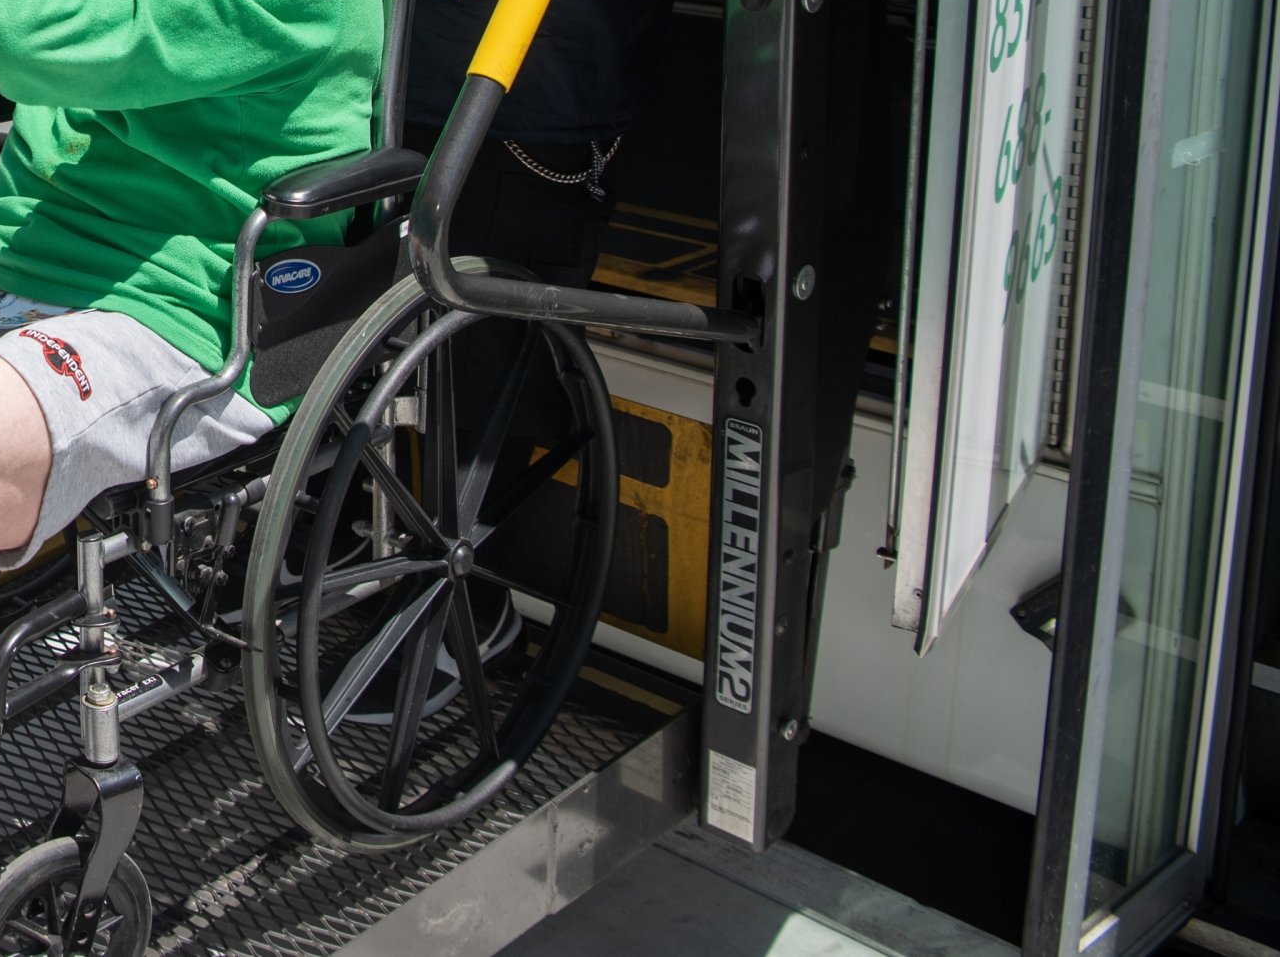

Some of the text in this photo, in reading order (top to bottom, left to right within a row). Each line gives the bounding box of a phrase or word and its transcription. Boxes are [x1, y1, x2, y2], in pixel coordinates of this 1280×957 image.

[994, 72, 1052, 204] 688-
[1002, 175, 1062, 326] 9663
[271, 267, 312, 286] INVACARE
[26, 330, 90, 392] INDEPENDENT
[729, 421, 759, 435] BRAUN
[719, 695, 748, 710] SERIES
